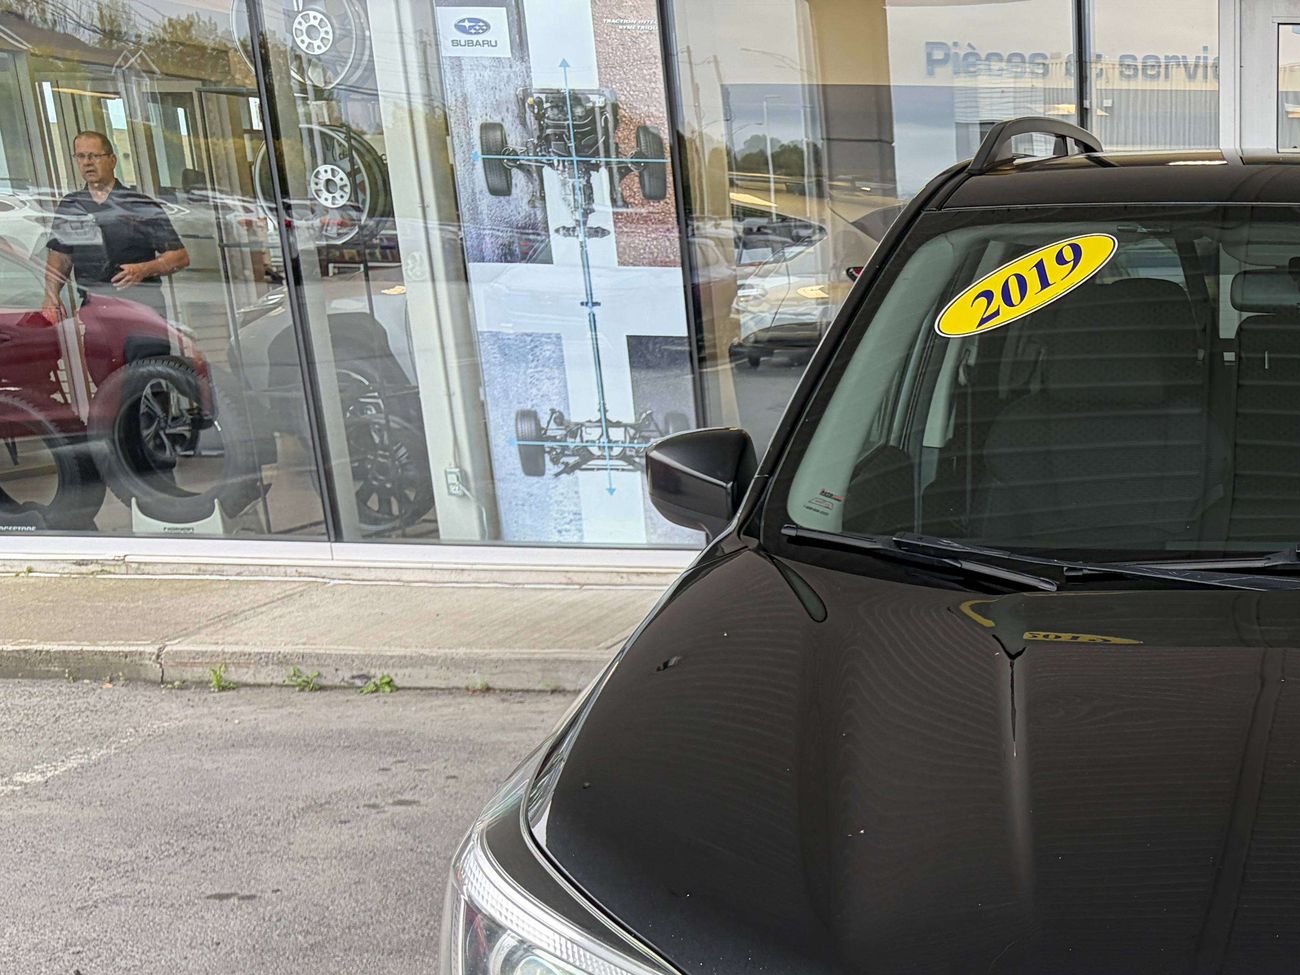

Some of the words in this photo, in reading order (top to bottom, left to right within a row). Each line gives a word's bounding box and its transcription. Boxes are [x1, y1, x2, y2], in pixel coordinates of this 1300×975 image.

[450, 39, 498, 48] SUBARU
[924, 41, 1049, 78] Pièces
[1118, 46, 1218, 82] servi
[970, 242, 1083, 329] 2019
